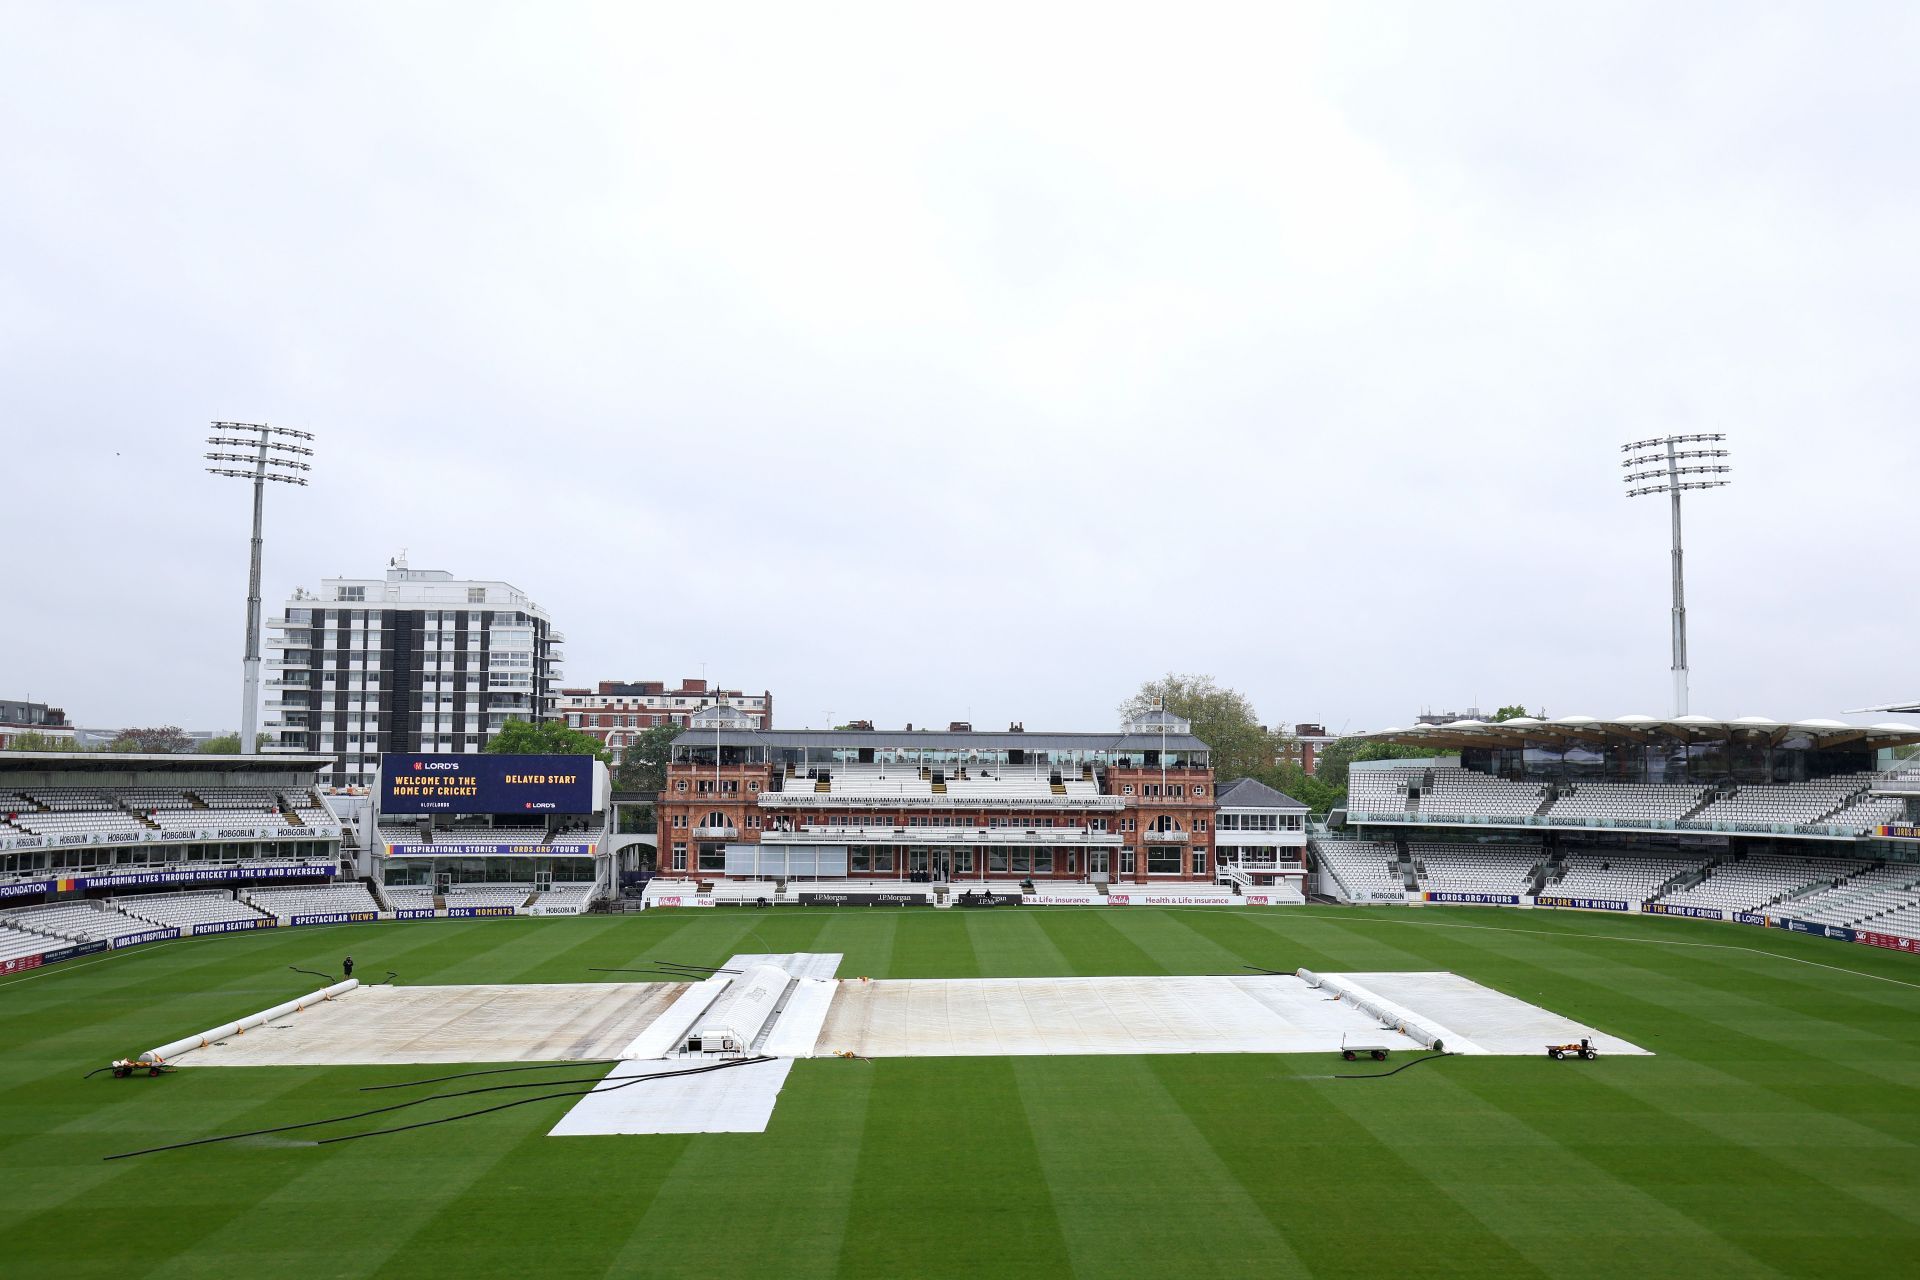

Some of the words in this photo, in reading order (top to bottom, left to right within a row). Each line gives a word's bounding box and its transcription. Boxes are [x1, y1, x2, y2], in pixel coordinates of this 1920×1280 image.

[395, 776, 440, 784] WELCOME
[443, 776, 454, 784] TO
[458, 776, 476, 785] THE
[506, 775, 544, 784] DELAYED
[548, 776, 576, 784] START
[394, 786, 419, 795] HOME
[422, 786, 434, 795] OF
[438, 786, 477, 795] CRICKET
[1428, 814, 1464, 823] HOBGOBLIN
[1488, 816, 1525, 825] HOBGOBLIN
[1549, 818, 1586, 826] HOBGOBLIN
[1614, 819, 1651, 828] HOBGOBLIN
[1675, 820, 1712, 830] HOBGOBLIN
[1735, 824, 1772, 832] HOBGOBLIN
[1794, 825, 1829, 835] HOBGOBLIN
[108, 832, 140, 842] HOBGOBLIN
[162, 830, 196, 840] HOBGOBLIN
[218, 828, 255, 838] HOBGOBLIN
[278, 828, 315, 836] HOBGOBLIN
[16, 836, 42, 848] HOBGOBLIN
[60, 834, 88, 845] HOBGOBLIN
[86, 876, 136, 887] TRANSFORMING
[138, 874, 159, 882] LIVES
[161, 871, 194, 881] THROUGH
[196, 870, 227, 879] CRICKET
[1, 883, 47, 896] FOUNDATION
[1371, 892, 1404, 900] HOBGOBLIN
[1437, 893, 1512, 903] LORDS.ORG/TOURS
[1538, 898, 1572, 906] EXPLORE
[1592, 900, 1624, 909] HISTORY
[546, 906, 576, 914] HOBGOBLIN
[1668, 906, 1685, 914] HOME
[1696, 909, 1721, 919] CRICKET
[296, 915, 348, 924] SPECTACULAR
[1742, 914, 1764, 924] LORD'S
[195, 924, 224, 934] PREMIUM
[226, 920, 254, 931] SEATING
[257, 919, 275, 927] WITH
[116, 928, 178, 947] LORDS.ORG/HOSPITALITY
